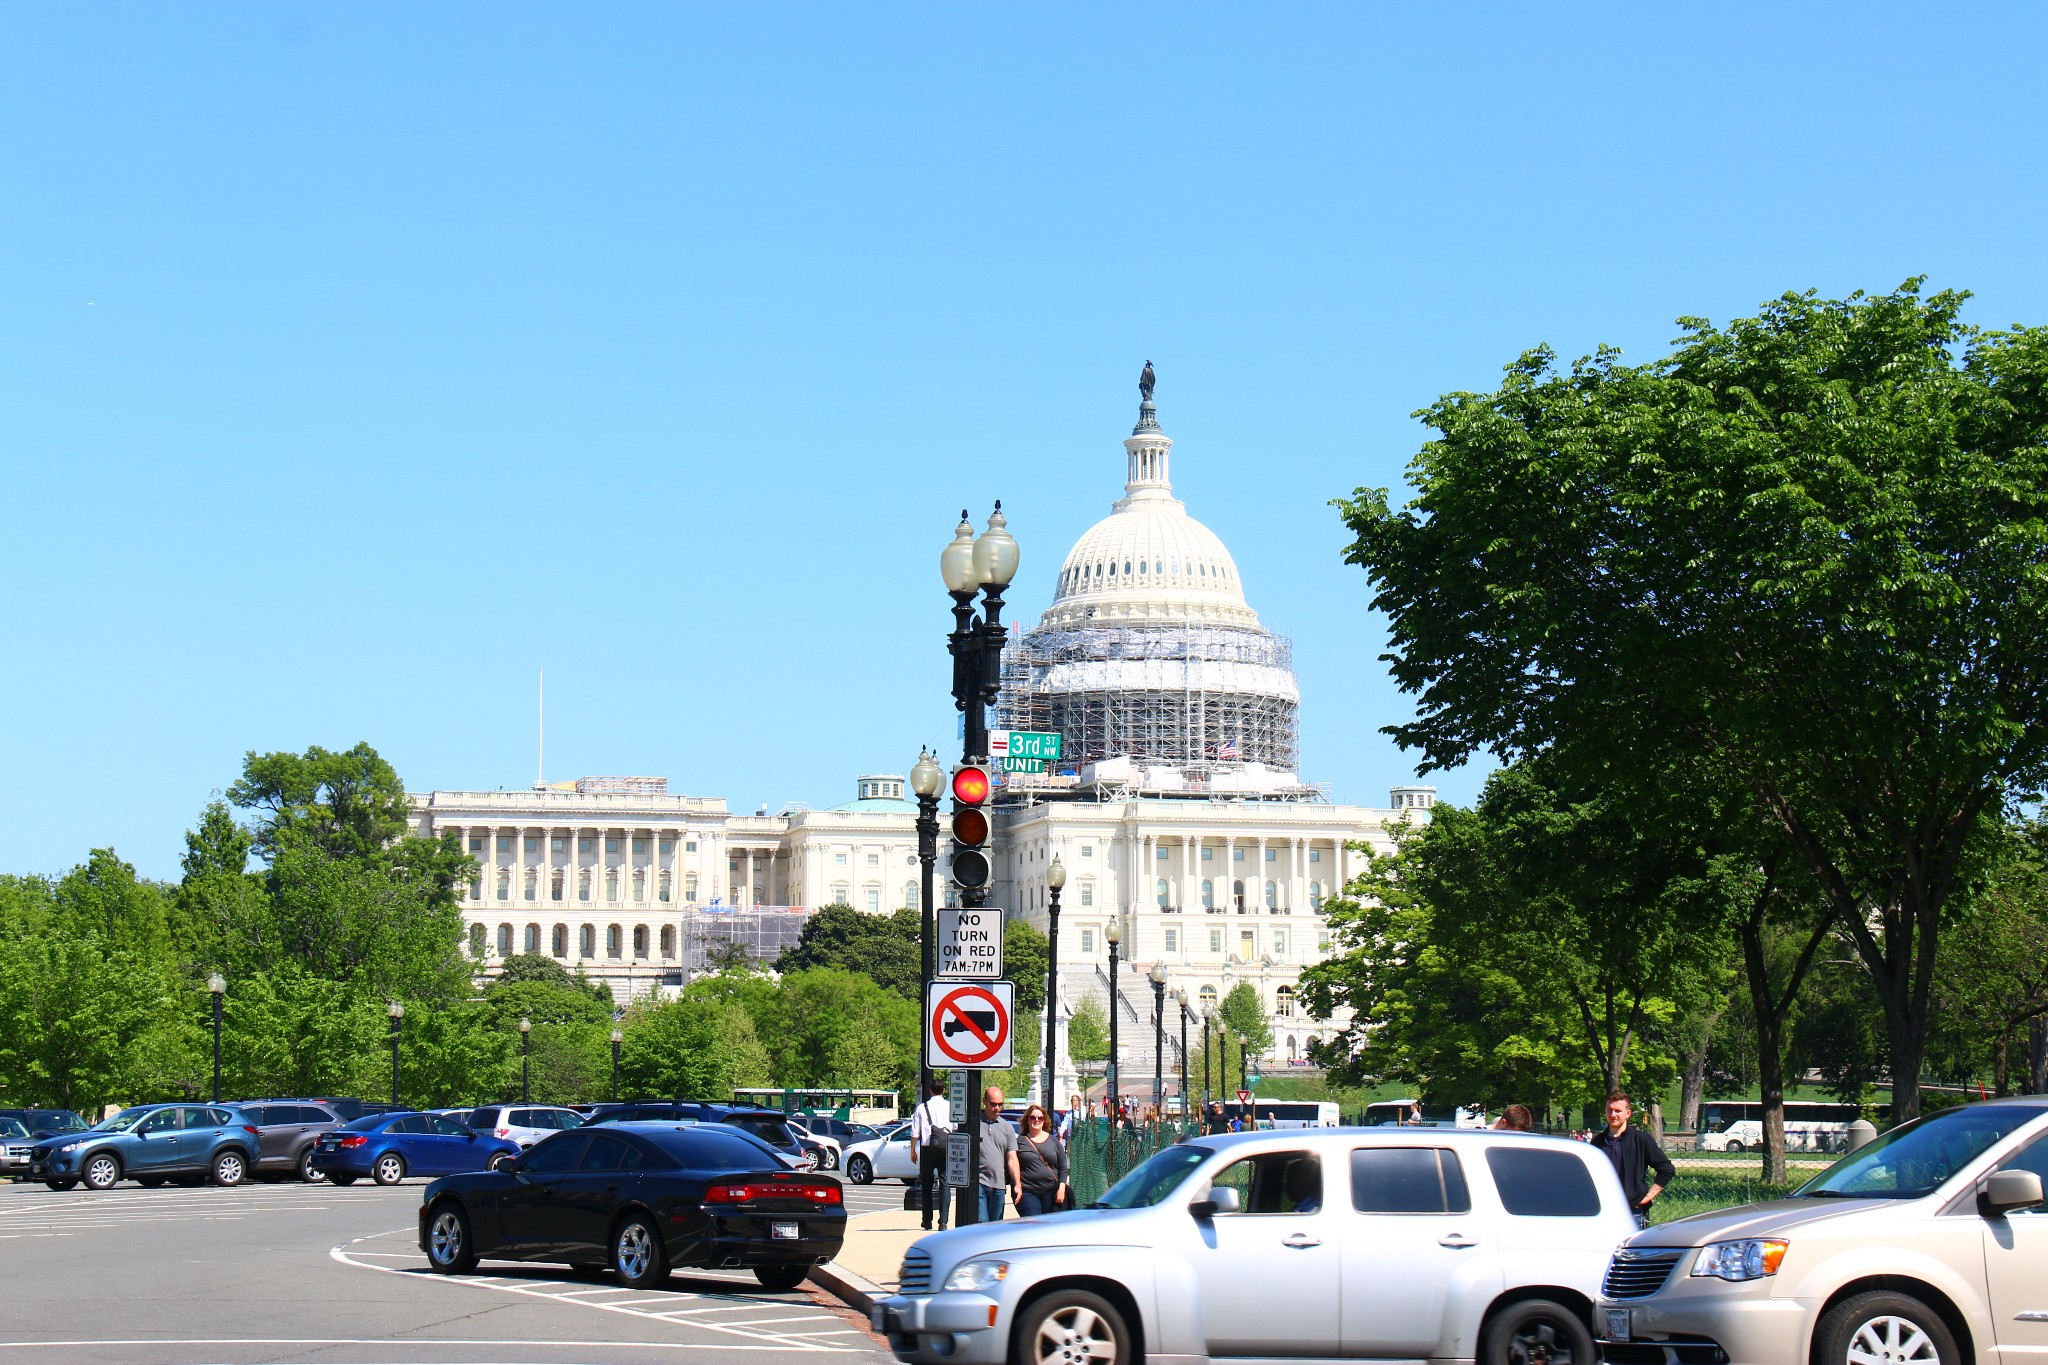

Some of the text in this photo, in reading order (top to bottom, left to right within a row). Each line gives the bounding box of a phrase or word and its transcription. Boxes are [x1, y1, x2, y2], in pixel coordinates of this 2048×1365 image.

[1012, 735, 1056, 755] 3rd ST
[1044, 747, 1056, 756] NW
[1003, 757, 1043, 772] UNIT
[958, 914, 981, 926] NO
[951, 930, 988, 942] TURN
[943, 945, 996, 957] ON RED
[944, 960, 993, 973] 7AM-7PM
